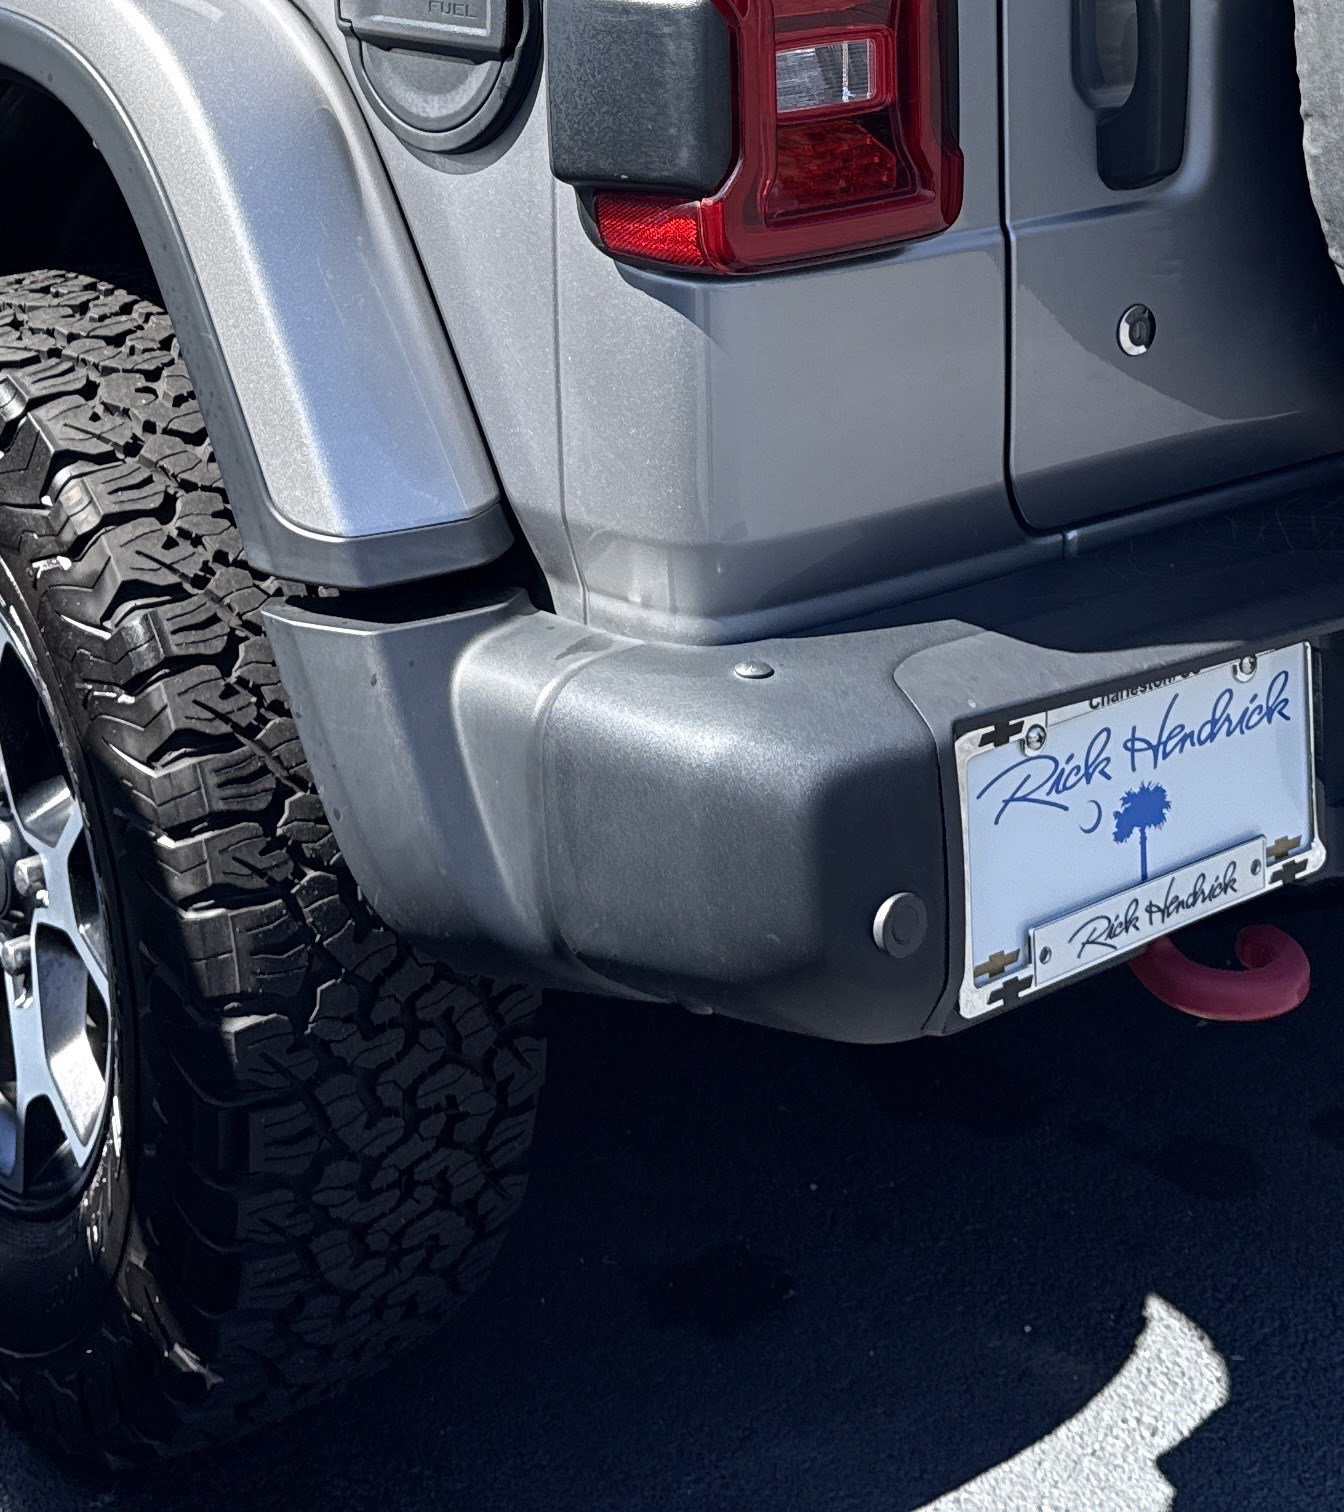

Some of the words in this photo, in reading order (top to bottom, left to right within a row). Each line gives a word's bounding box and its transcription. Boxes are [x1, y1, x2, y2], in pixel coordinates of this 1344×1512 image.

[976, 726, 1113, 826] Rick
[1123, 670, 1291, 773] Hendrick
[1067, 898, 1141, 960] Rick
[1144, 860, 1239, 928] Hendrick
